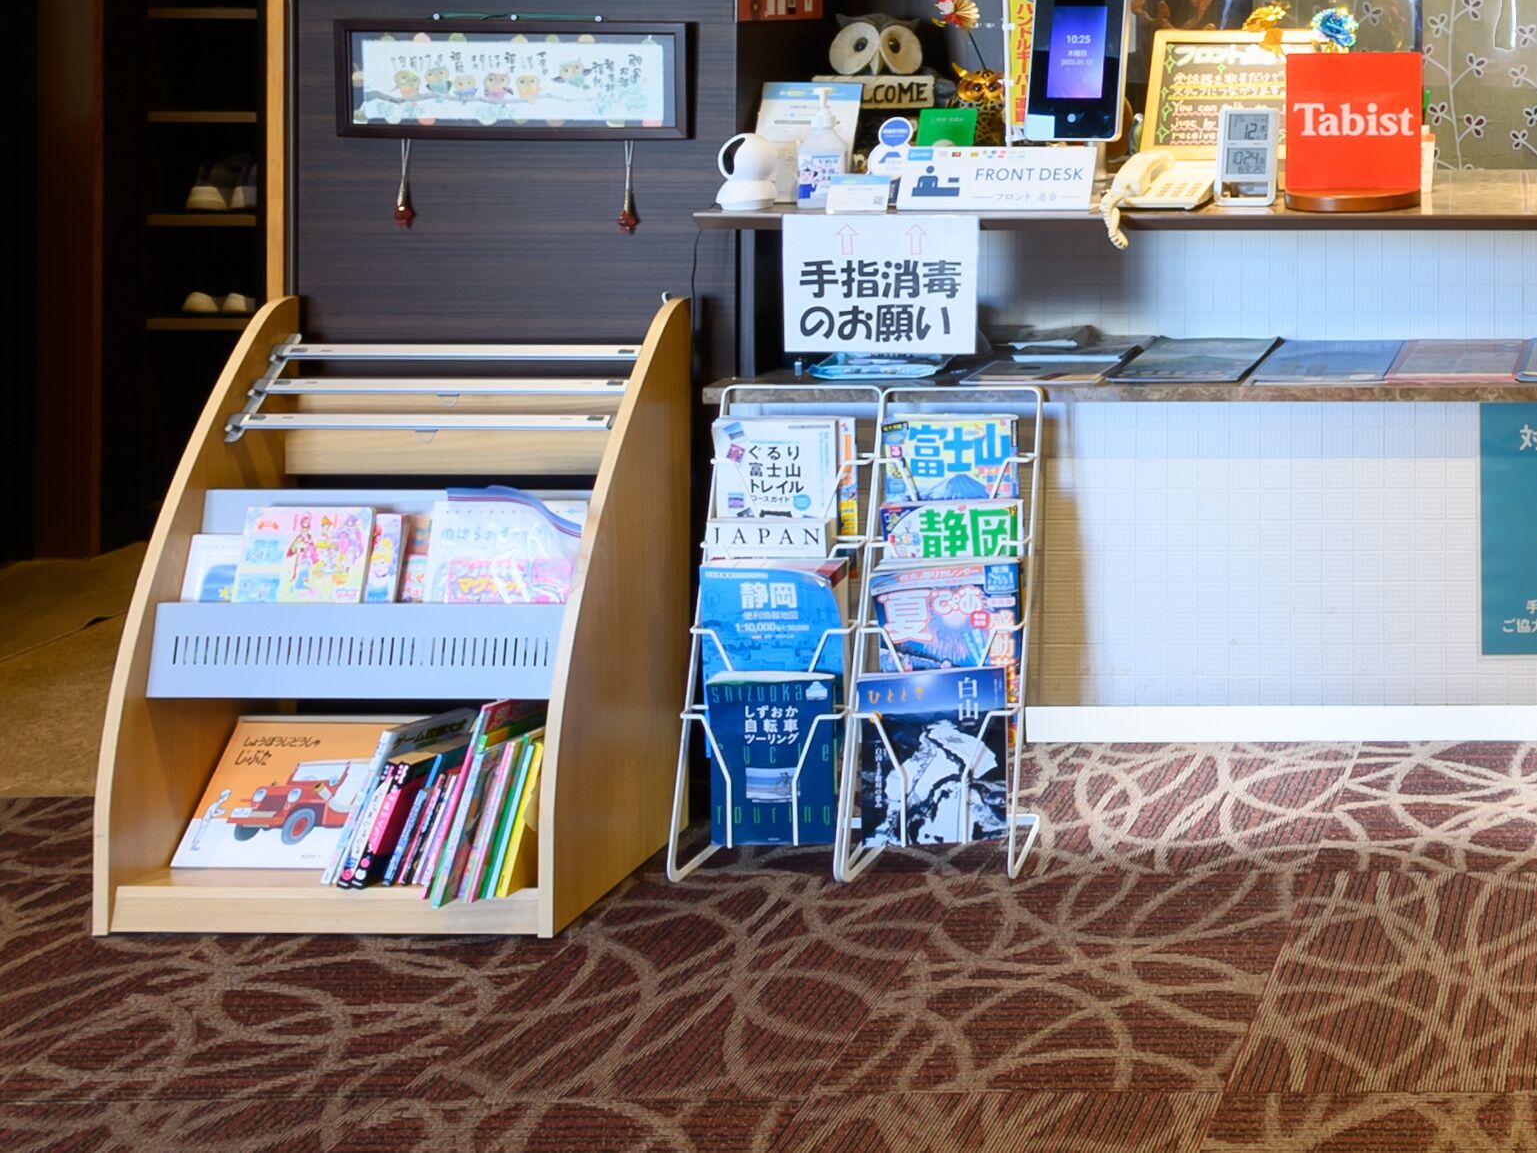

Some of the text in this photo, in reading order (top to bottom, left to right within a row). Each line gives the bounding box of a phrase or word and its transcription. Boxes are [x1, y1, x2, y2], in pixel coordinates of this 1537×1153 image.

[1066, 35, 1091, 45] 10:25
[863, 82, 928, 104] LCOME
[1171, 100, 1193, 112] You
[1198, 104, 1218, 112] can
[1293, 103, 1414, 137] Tabist
[974, 167, 1084, 181] FRONT DESK
[996, 193, 1030, 202] フロント
[800, 259, 962, 300] 手指消毒
[800, 304, 951, 342] のお願い
[748, 445, 800, 461] ぐるり
[908, 423, 1012, 478] 富士山
[749, 463, 801, 478] 富士山
[750, 480, 804, 494] トレイル
[751, 495, 791, 503] コースガイド
[714, 527, 820, 545] JAPAN
[919, 508, 1018, 558] 静岡
[740, 582, 798, 609] 静岡
[958, 677, 979, 721] 白山
[744, 705, 798, 718] しずおか
[744, 719, 799, 733] 自転車
[744, 733, 800, 745] ツーリング
